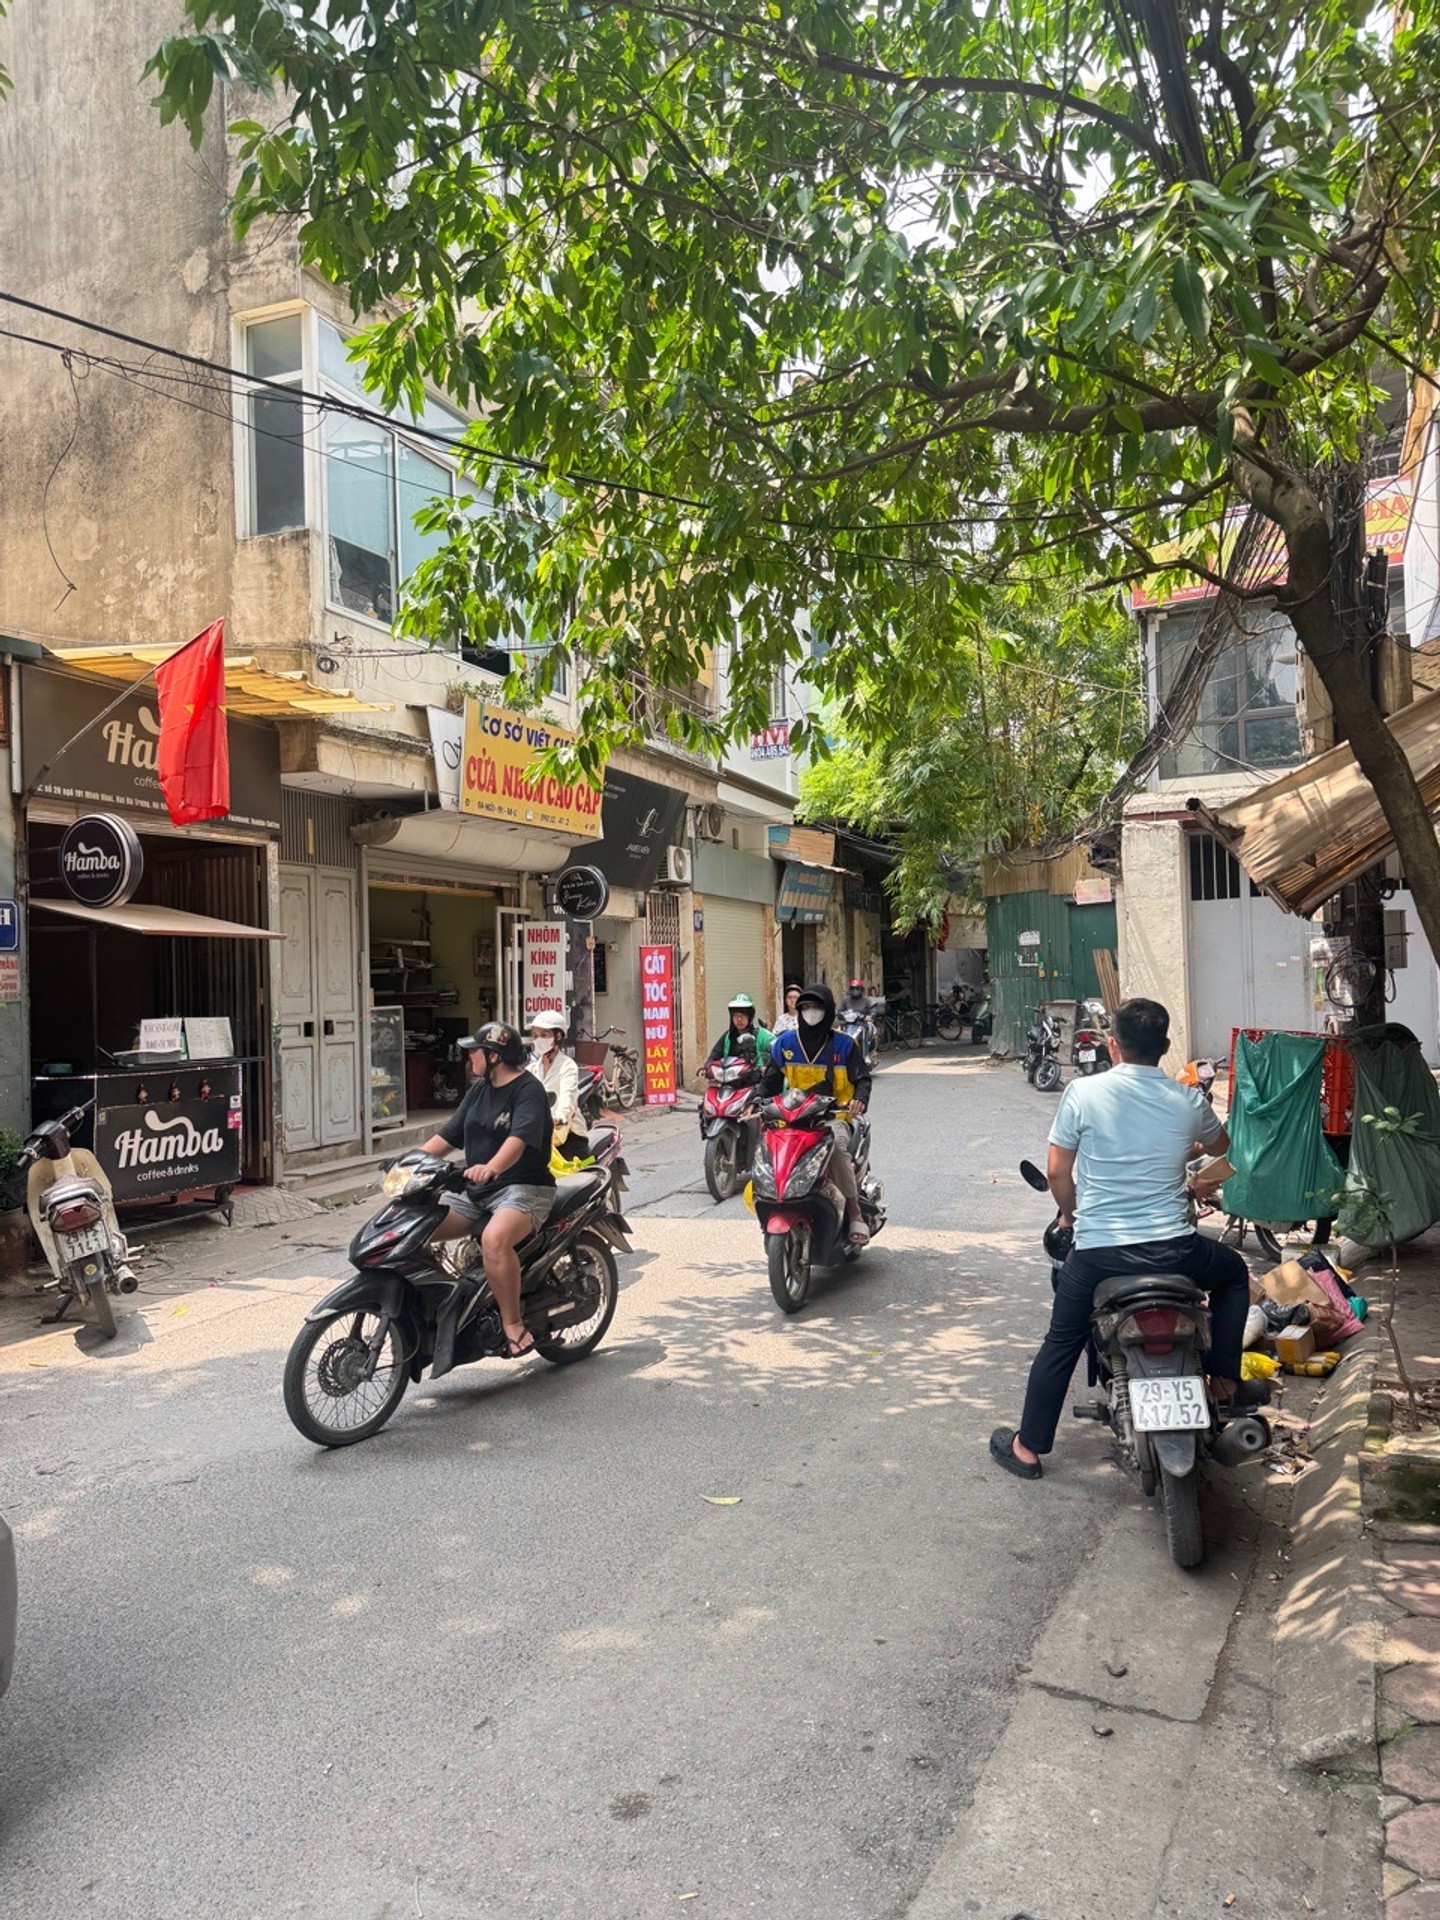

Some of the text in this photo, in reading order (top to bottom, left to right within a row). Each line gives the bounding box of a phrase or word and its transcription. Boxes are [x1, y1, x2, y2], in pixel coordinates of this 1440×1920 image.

[504, 717, 523, 742] SỞ
[466, 747, 497, 795] CỬA
[64, 842, 120, 872] Hamba
[527, 926, 560, 943] NHÔM
[530, 948, 557, 965] KÍNH
[532, 970, 555, 991] VIỆT
[643, 980, 668, 1002] TÓC
[525, 994, 562, 1012] CƯỜNG
[643, 1006, 670, 1020] NAM
[645, 1024, 669, 1040] NỮ
[646, 1044, 669, 1058] LẤY
[650, 1077, 671, 1089] TAI
[114, 1110, 224, 1168] Hamba
[1139, 1381, 1194, 1402] 29-Y5
